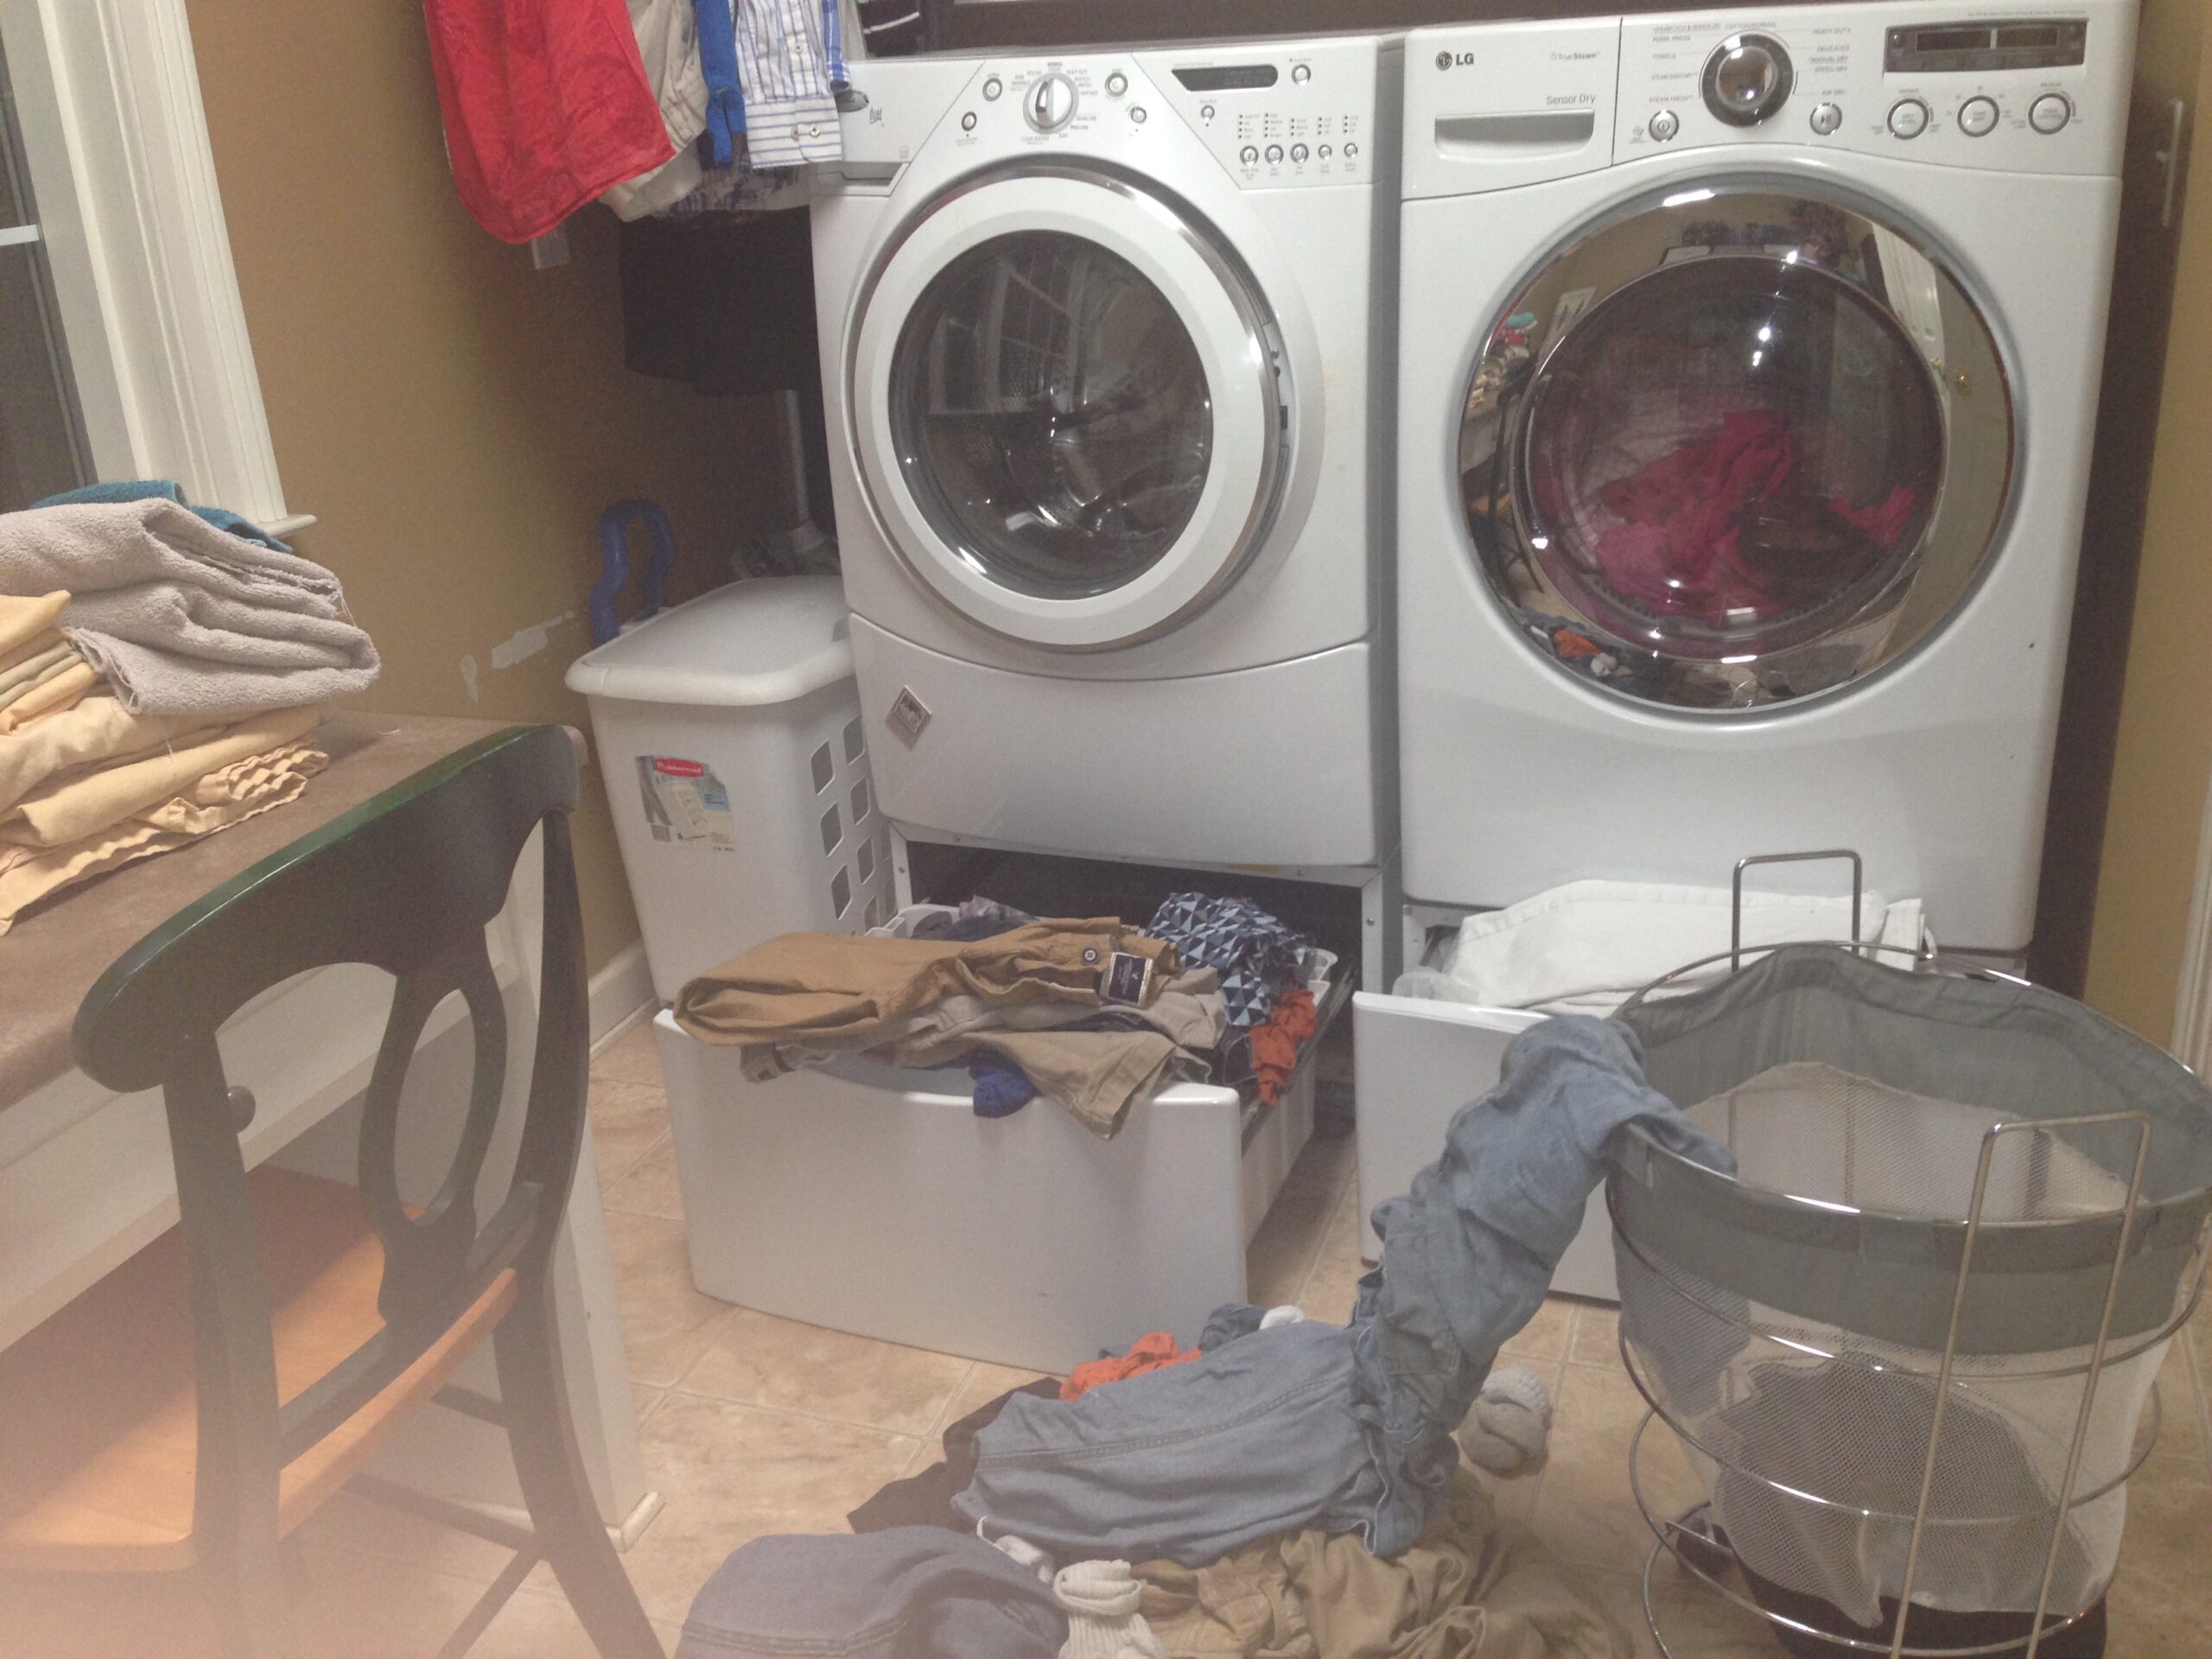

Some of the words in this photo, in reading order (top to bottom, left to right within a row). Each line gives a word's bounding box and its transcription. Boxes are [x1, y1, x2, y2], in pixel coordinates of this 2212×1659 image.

[1455, 53, 1474, 66] LG
[1547, 94, 1577, 105] Sensor
[1579, 92, 1596, 104] Dry
